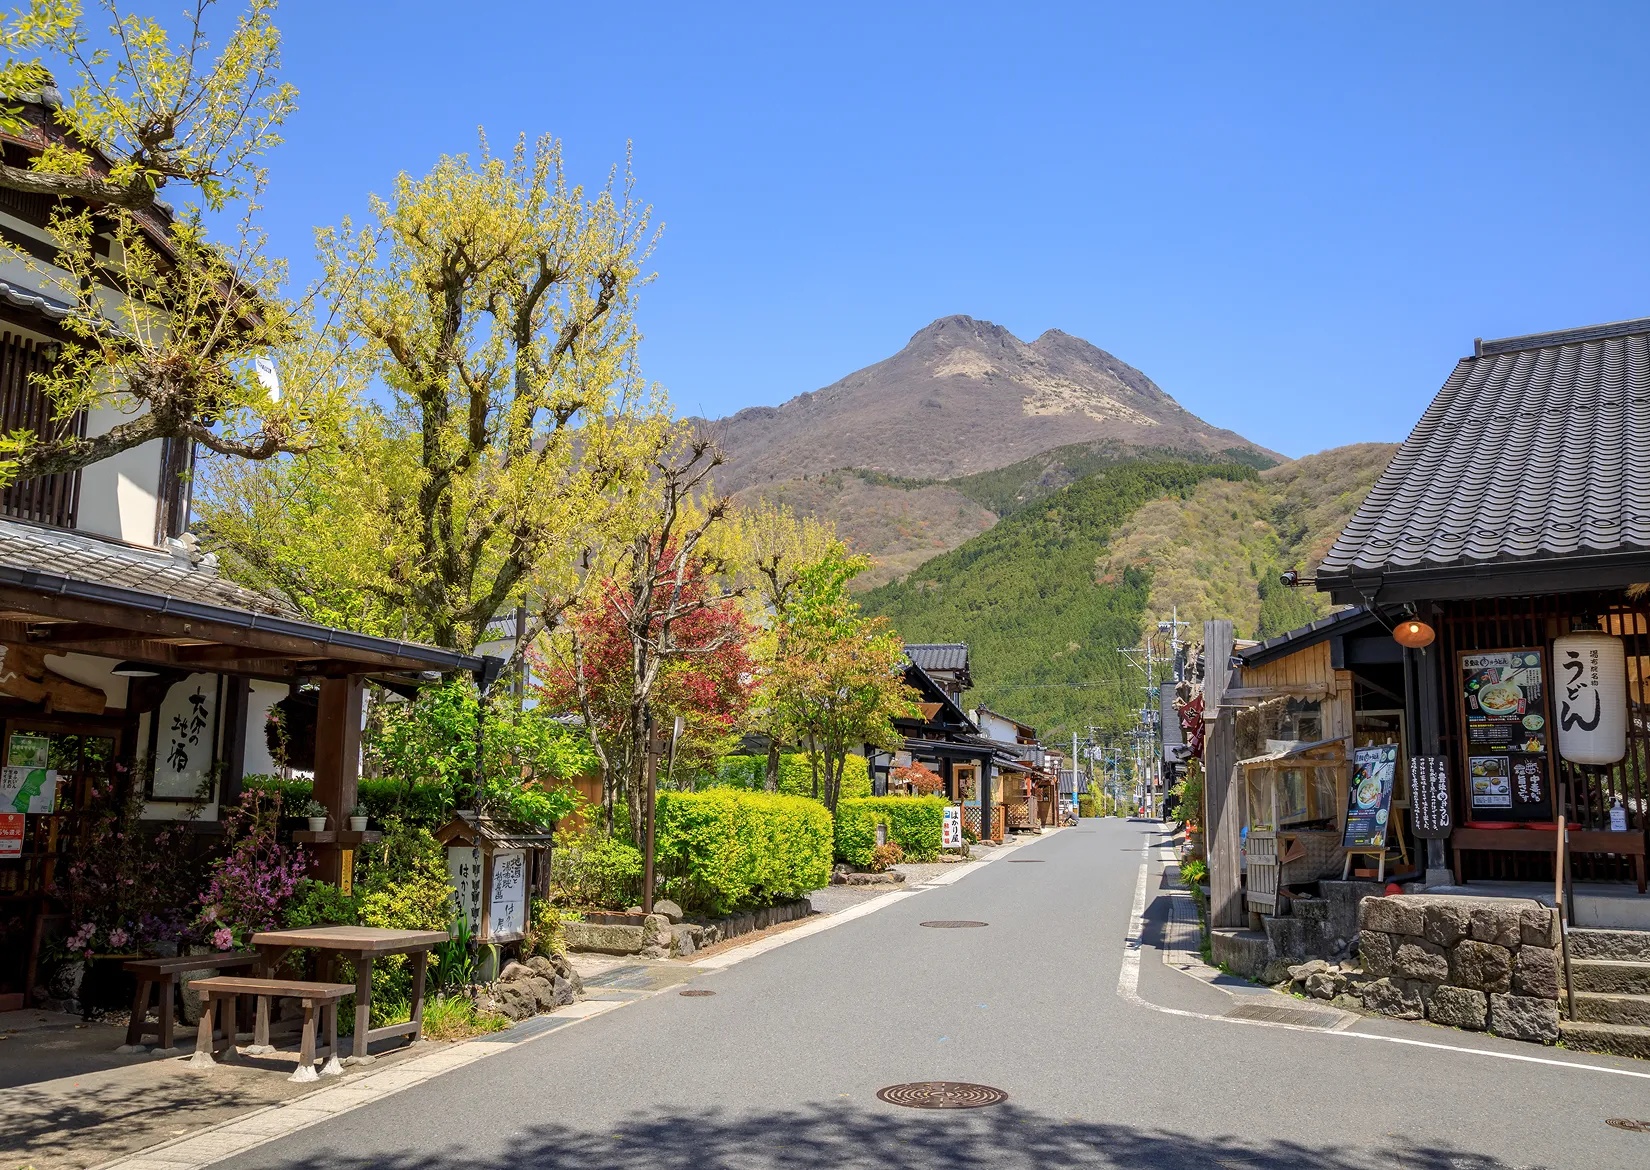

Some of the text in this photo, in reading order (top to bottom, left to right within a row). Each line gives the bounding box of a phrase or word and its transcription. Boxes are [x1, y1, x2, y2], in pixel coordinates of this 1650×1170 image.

[1561, 651, 1601, 732] うどん
[1590, 650, 1599, 686] 湯布院名物
[188, 686, 209, 746] 大分の
[167, 713, 189, 773] 地酒
[951, 811, 959, 843] はかり屋
[502, 861, 513, 889] 湯布院
